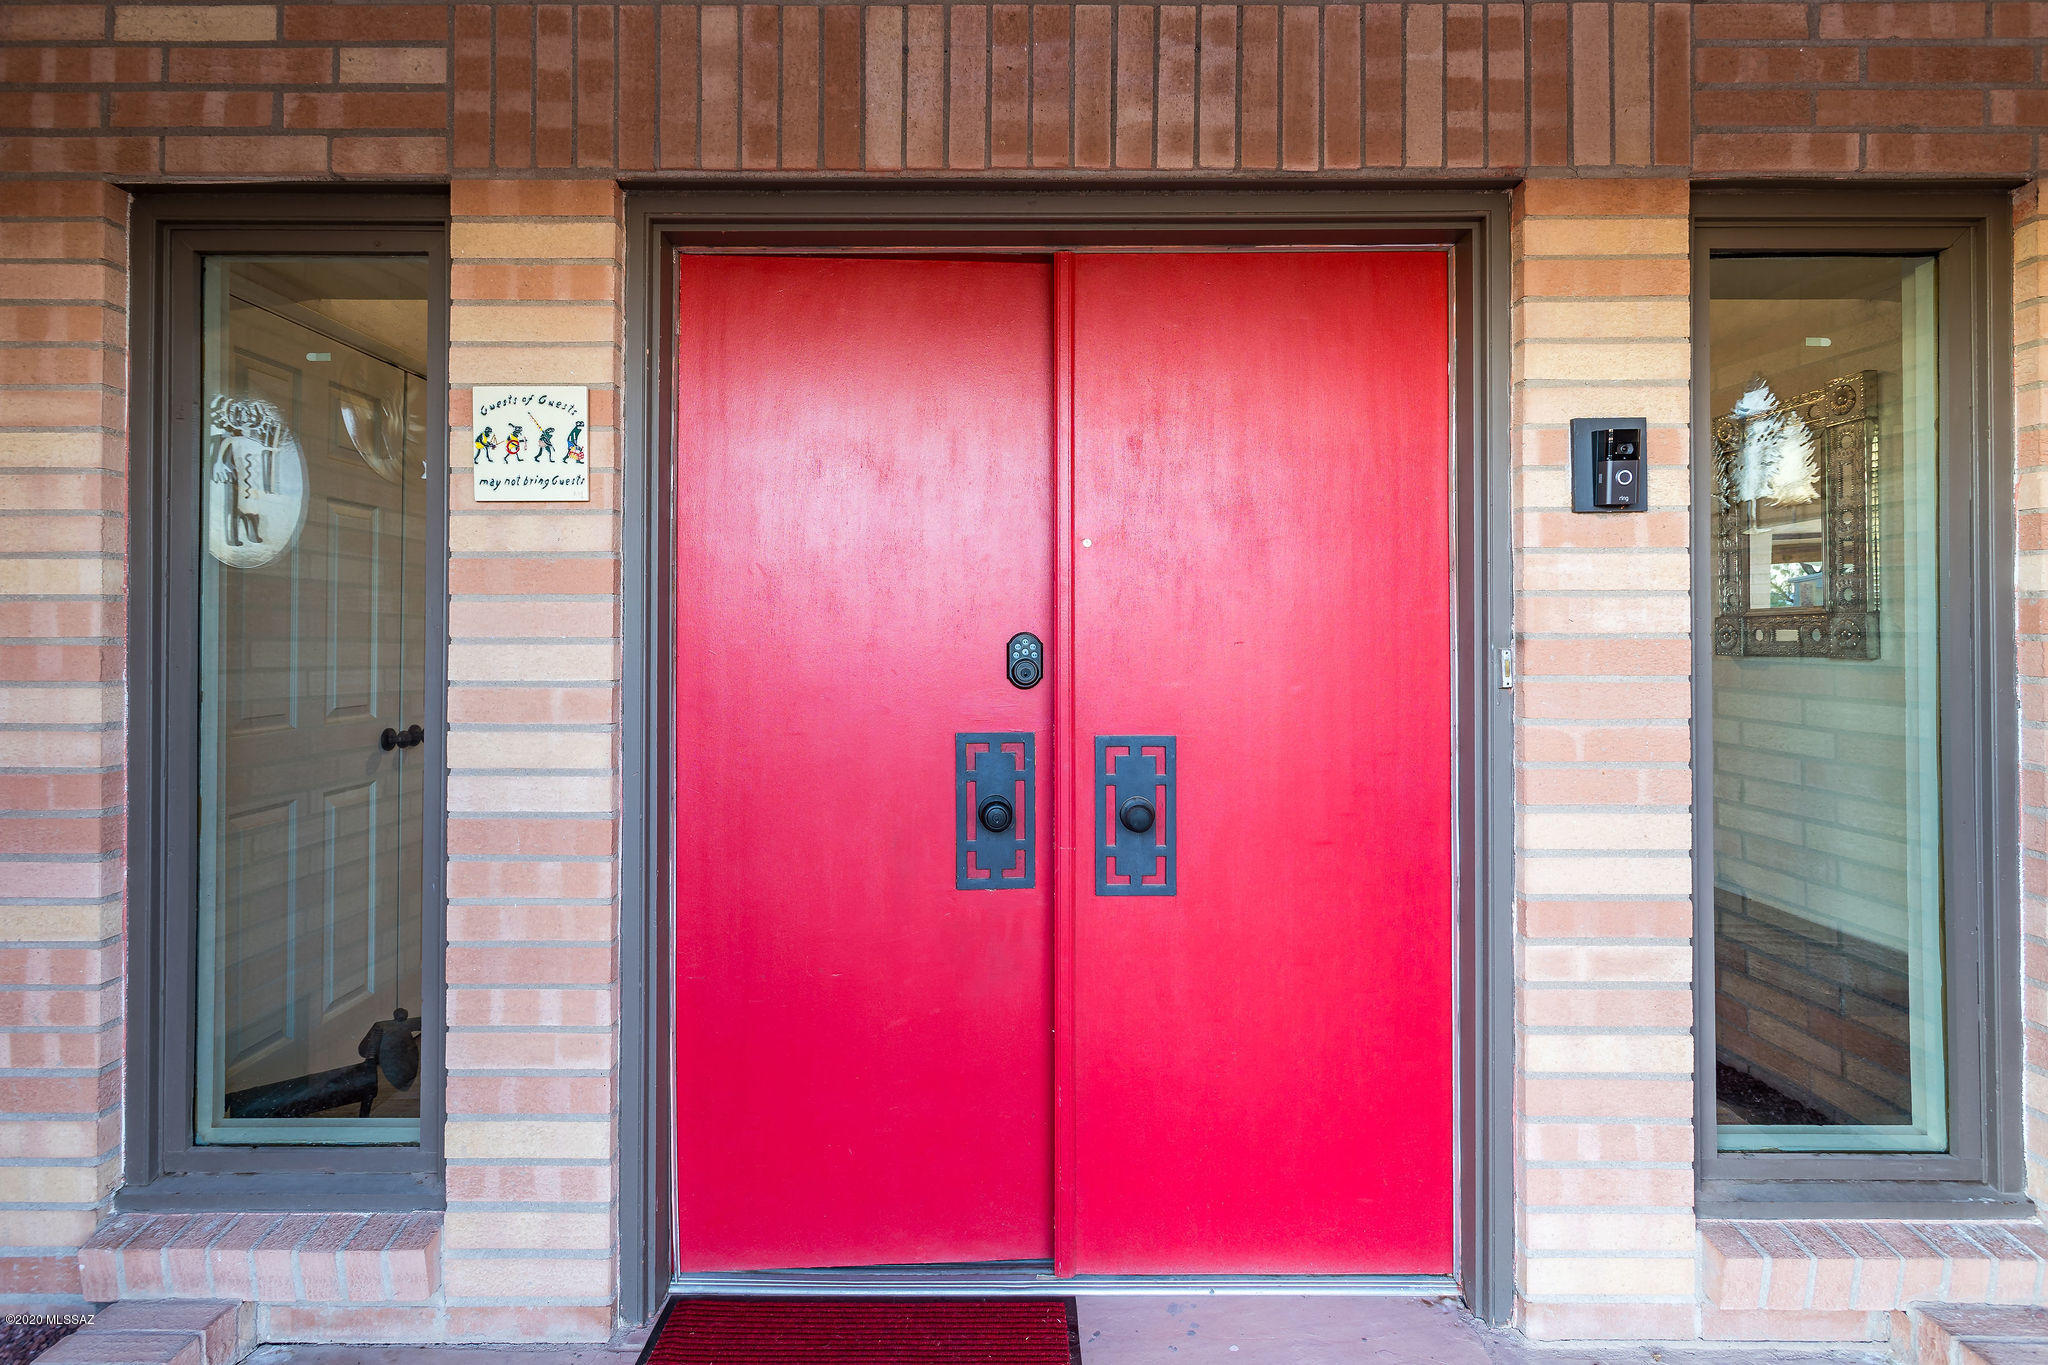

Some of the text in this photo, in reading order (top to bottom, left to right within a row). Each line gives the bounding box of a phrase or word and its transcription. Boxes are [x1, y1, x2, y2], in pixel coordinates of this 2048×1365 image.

[480, 394, 578, 416] Guests of Guests
[479, 475, 585, 491] may not bring Guests
